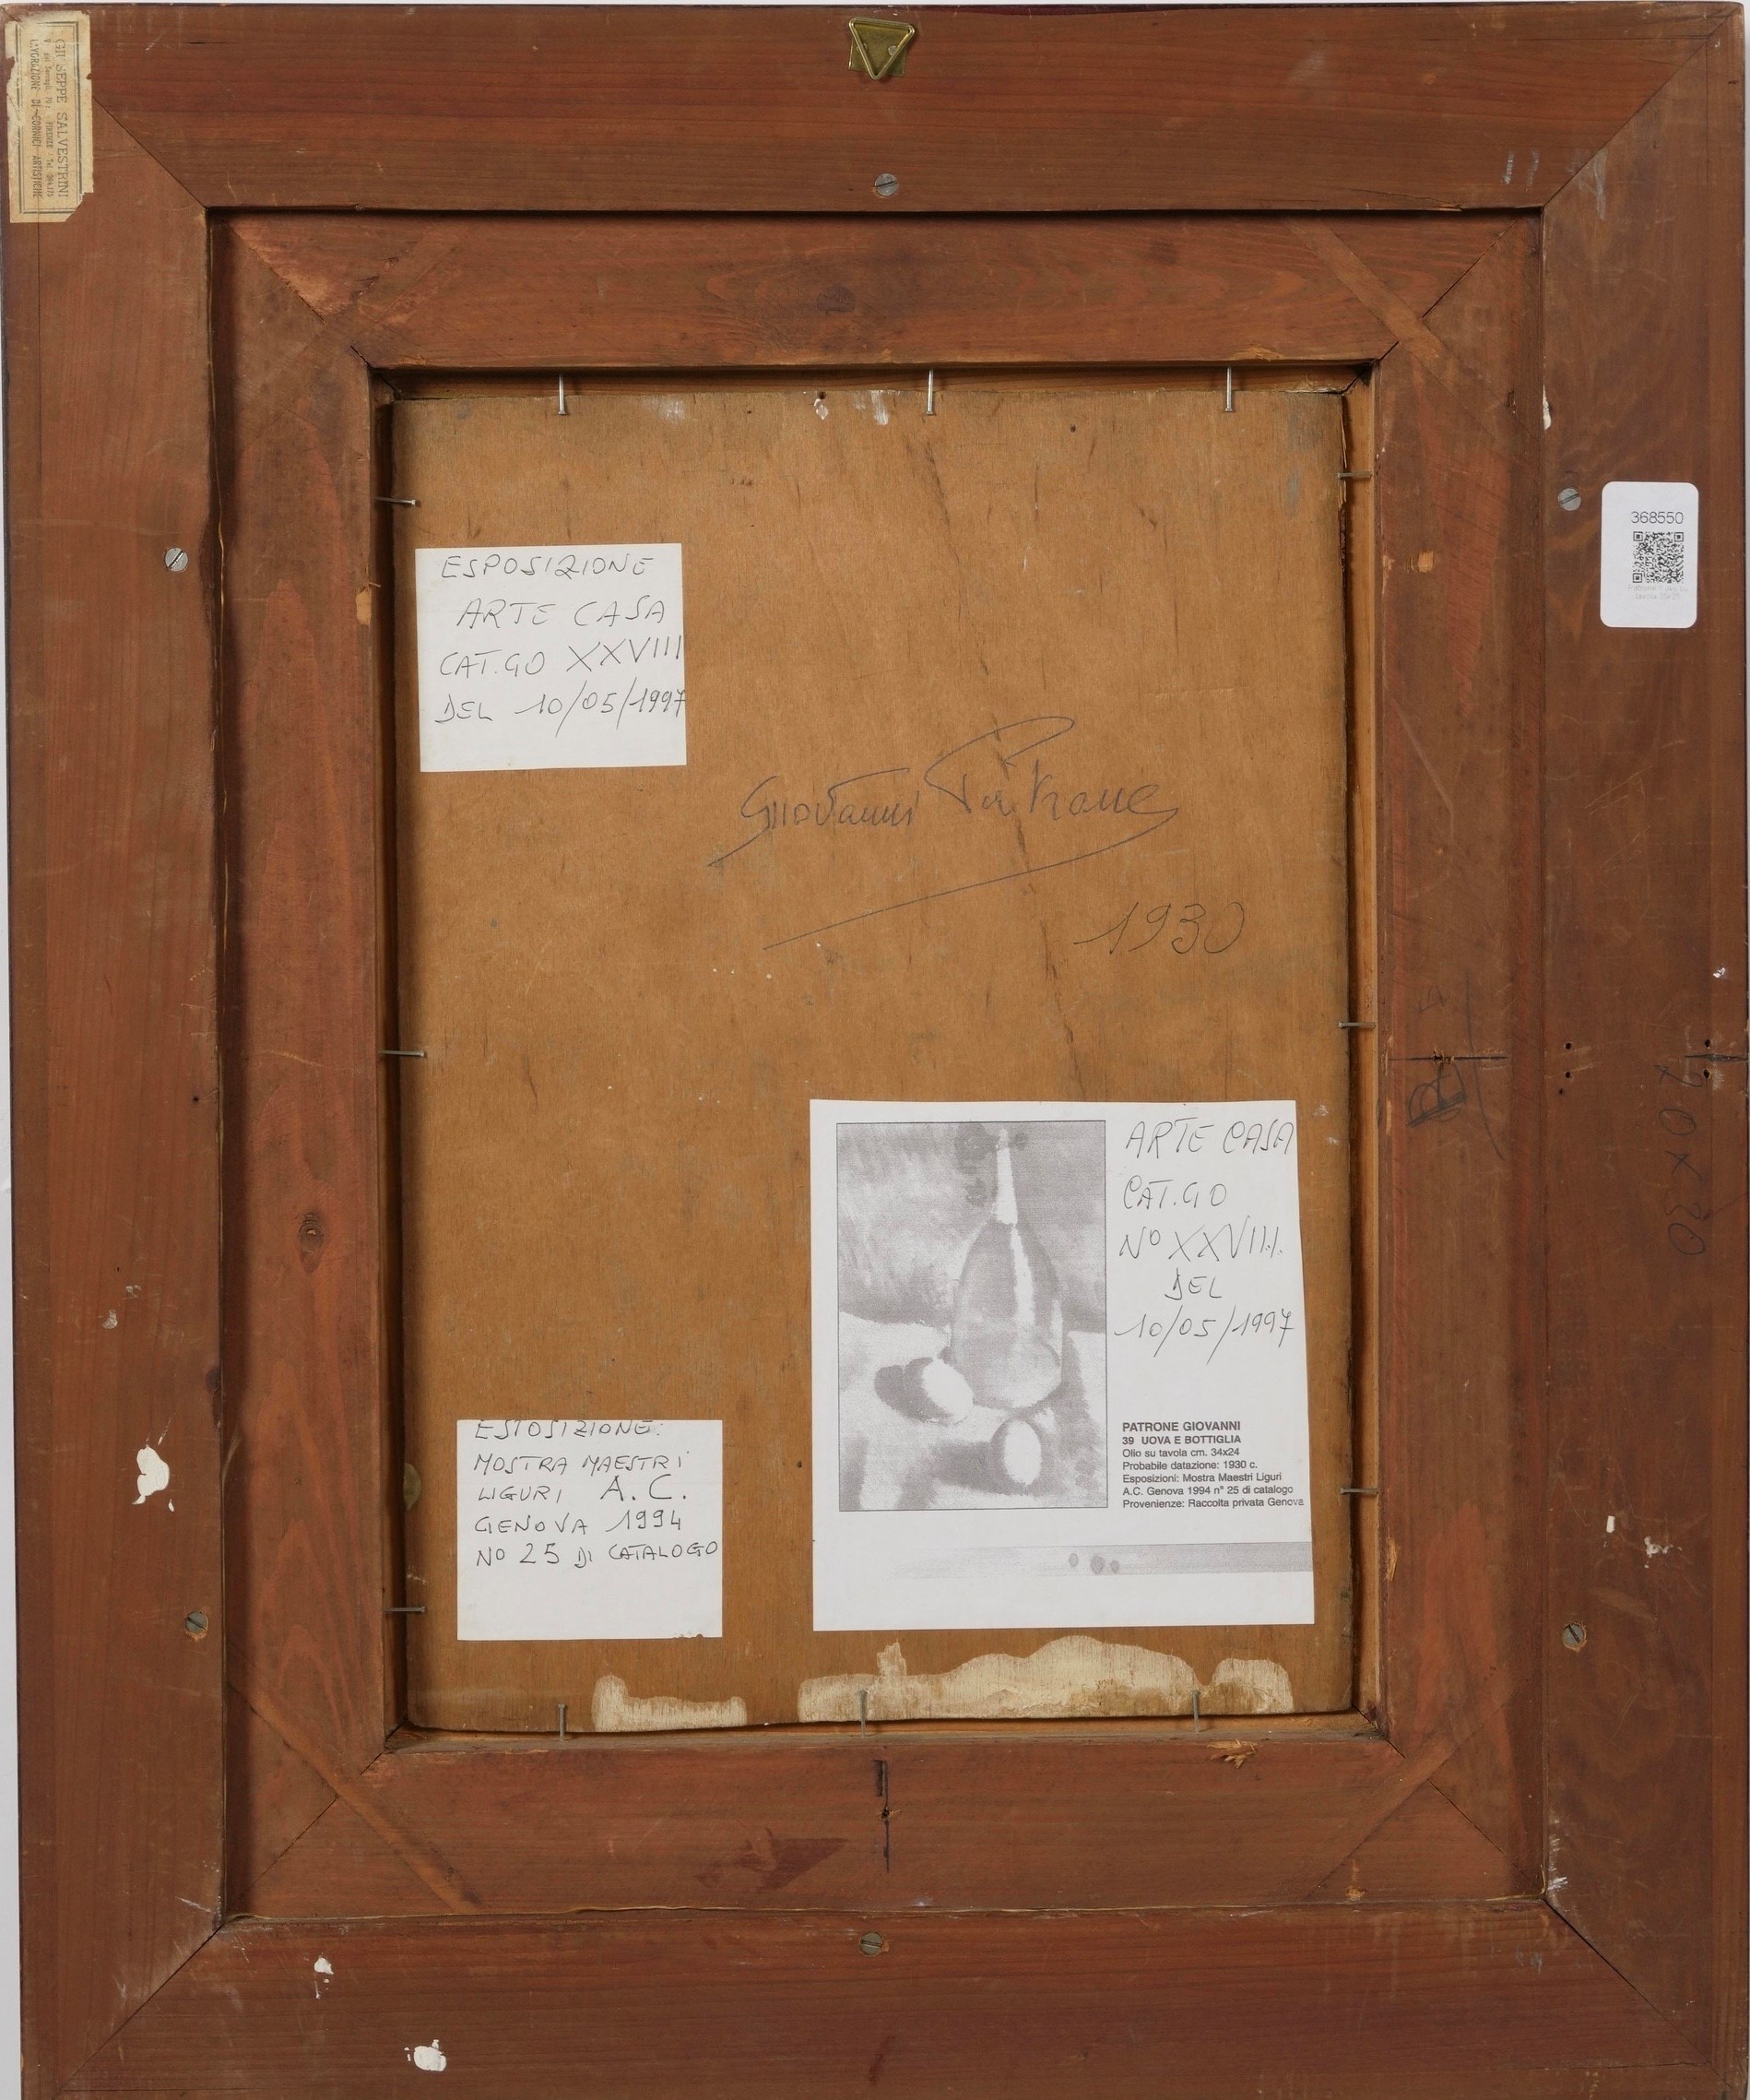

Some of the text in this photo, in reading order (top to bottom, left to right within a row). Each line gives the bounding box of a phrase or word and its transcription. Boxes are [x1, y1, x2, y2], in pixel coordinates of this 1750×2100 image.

[30, 99, 41, 108] DI
[31, 115, 41, 148] CORNICI
[45, 122, 53, 148] FIRENZE
[57, 112, 69, 198] SALVESTRINI
[31, 156, 42, 198] ARTISTICHE
[1630, 510, 1684, 524] 368550
[441, 552, 655, 579] ESPOSIZIONE
[455, 594, 665, 629] ARTE CASA
[439, 635, 682, 679] CAT.GO XXVIII
[433, 676, 686, 738] DEL 10/05/1997
[1072, 901, 1247, 955] 1930
[1125, 1116, 1295, 1159] ARTE CASA
[1164, 1267, 1223, 1300] DEL
[1113, 1303, 1295, 1365] 10/05/1997
[1121, 1434, 1242, 1445] 39 UOVA E BOTTIGLIA
[1122, 1421, 1241, 1432] PATRONE GIOVANNI
[473, 1451, 690, 1477] MOSTRA MAESTRI
[1122, 1448, 1141, 1458] Olio
[1158, 1448, 1188, 1457] tavola
[1189, 1449, 1208, 1457] cm.
[1211, 1447, 1240, 1456] 34x24
[1122, 1460, 1258, 1471] Probabile datazione: 1930 c.
[1122, 1472, 1283, 1485] Esposizioni: Mostra Maestri Liguri
[1122, 1486, 1143, 1496] A.C.
[1146, 1486, 1184, 1496] Genova
[1188, 1486, 1212, 1495] 1994
[1226, 1485, 1239, 1494] 25
[1242, 1485, 1251, 1494] di
[1253, 1484, 1294, 1496] catalogo
[478, 1485, 562, 1503] LIGURI
[1122, 1497, 1305, 1509] Provenienze: Raccolta privata Genova
[473, 1509, 682, 1535] GENOVA 1994
[519, 1542, 561, 1565] 25
[608, 1540, 718, 1560] CATALOGO
